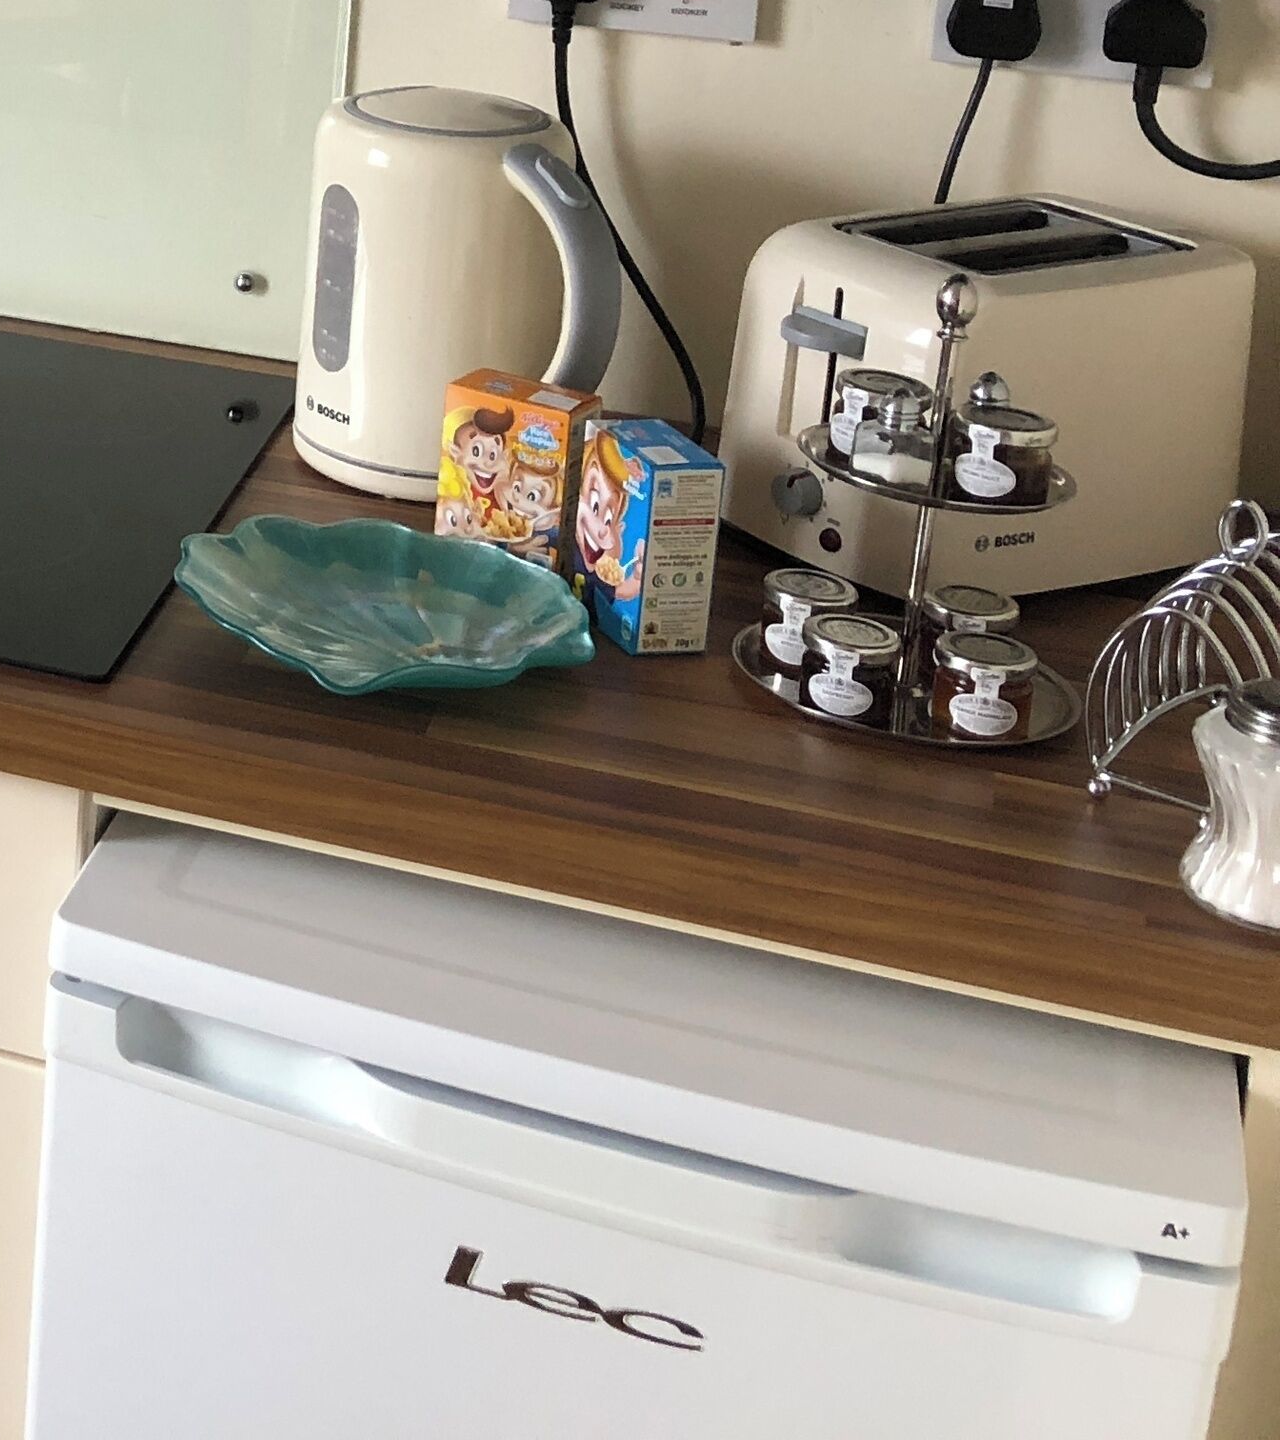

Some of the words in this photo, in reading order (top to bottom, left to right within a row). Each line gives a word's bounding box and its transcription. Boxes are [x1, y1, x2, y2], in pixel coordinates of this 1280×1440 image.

[317, 403, 350, 425] BOSCH
[994, 531, 1035, 548] BOSCH
[1161, 1223, 1191, 1240] A+
[443, 1244, 705, 1351] Lec
